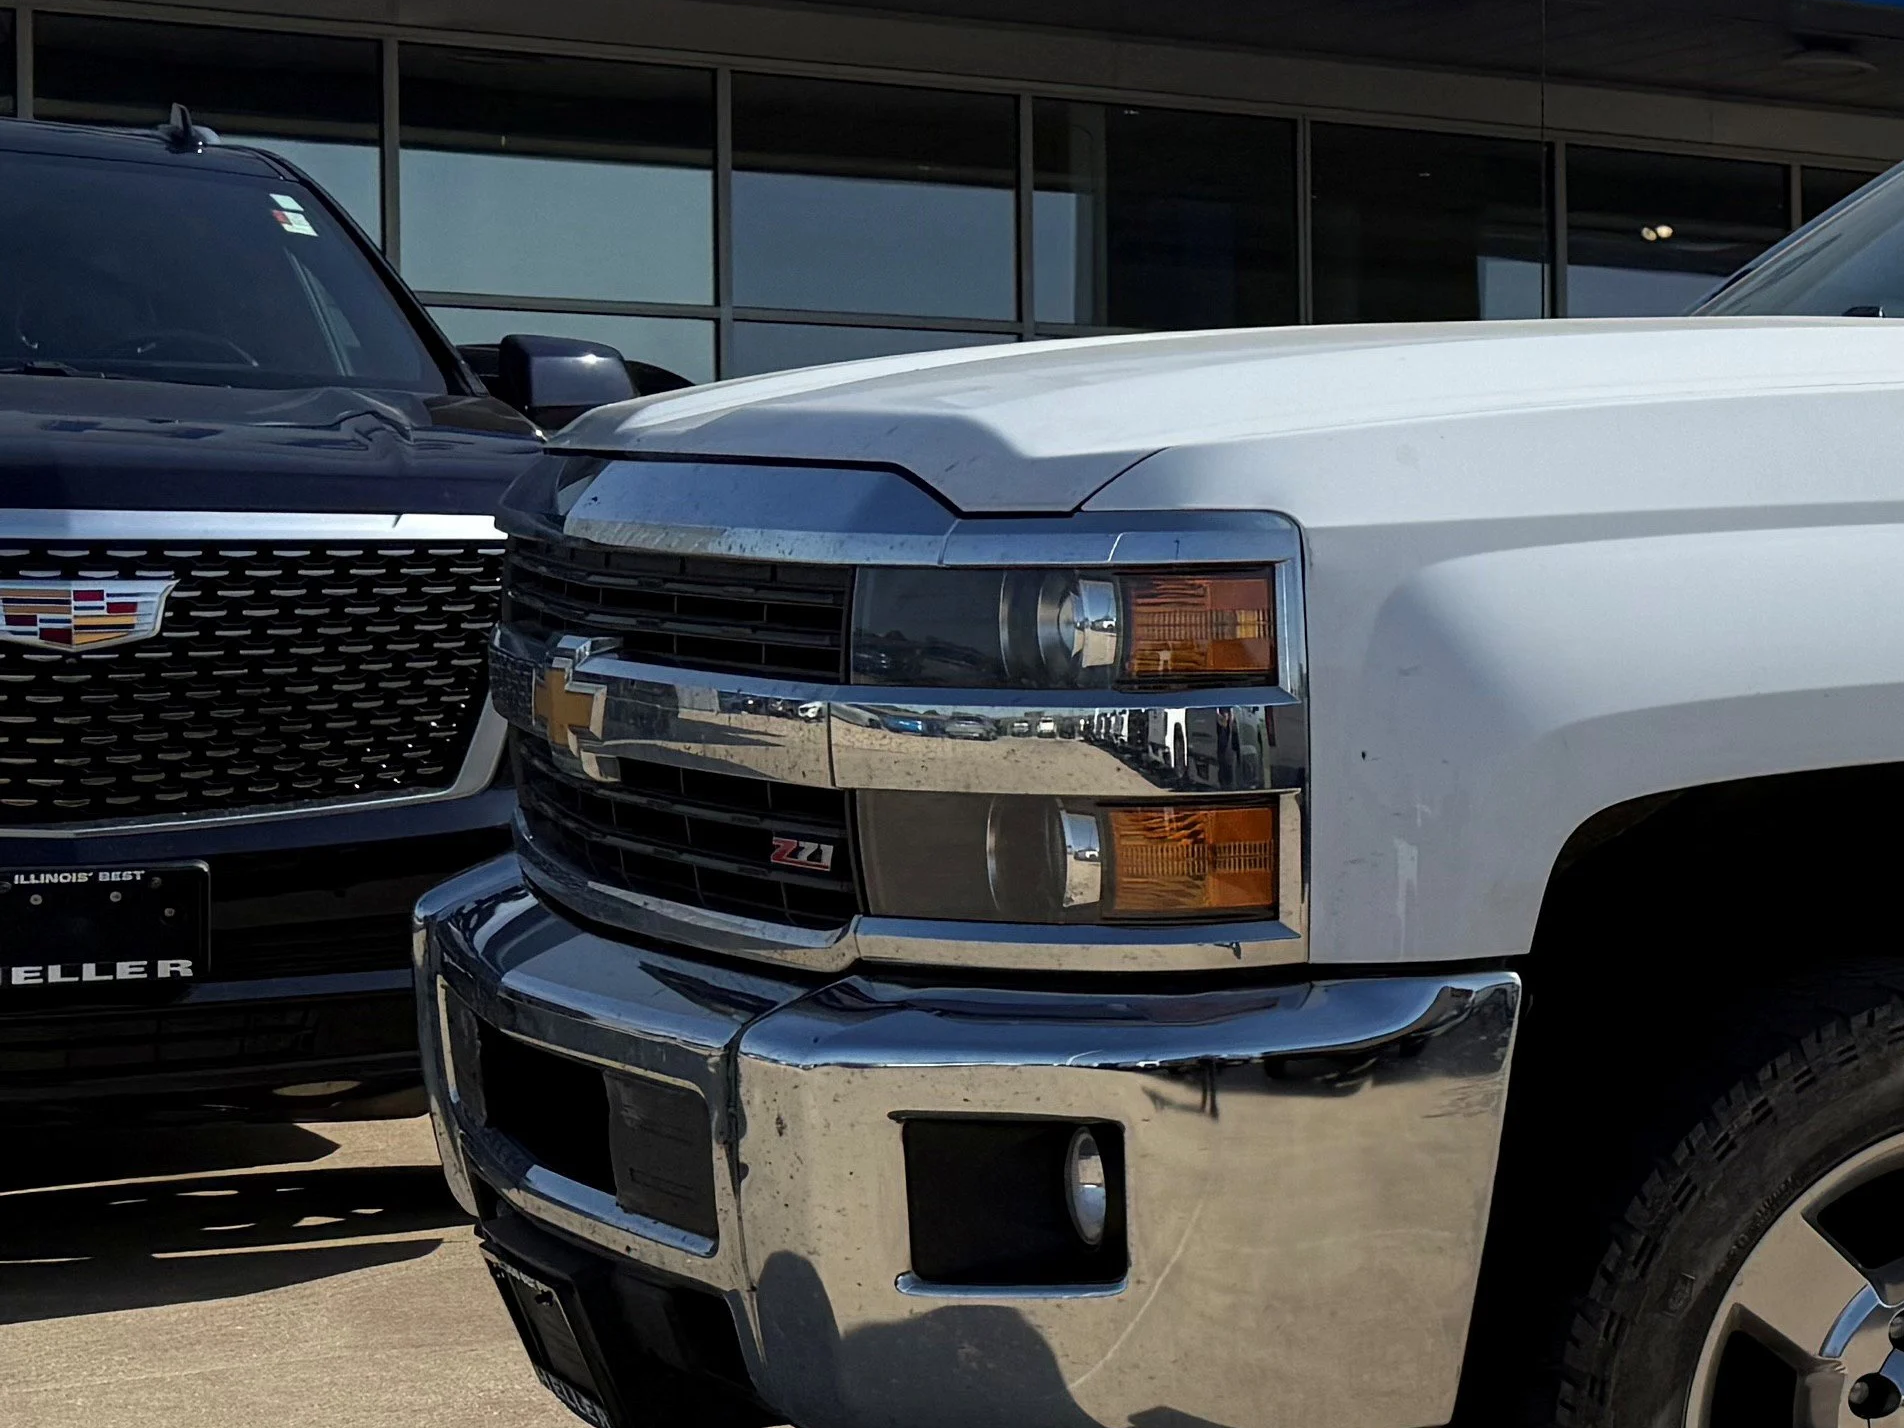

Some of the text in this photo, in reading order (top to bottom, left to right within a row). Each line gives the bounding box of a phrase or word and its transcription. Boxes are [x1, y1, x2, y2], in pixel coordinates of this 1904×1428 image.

[770, 836, 834, 872] Z71
[98, 870, 146, 882] BEST
[0, 959, 194, 985] ELLER
